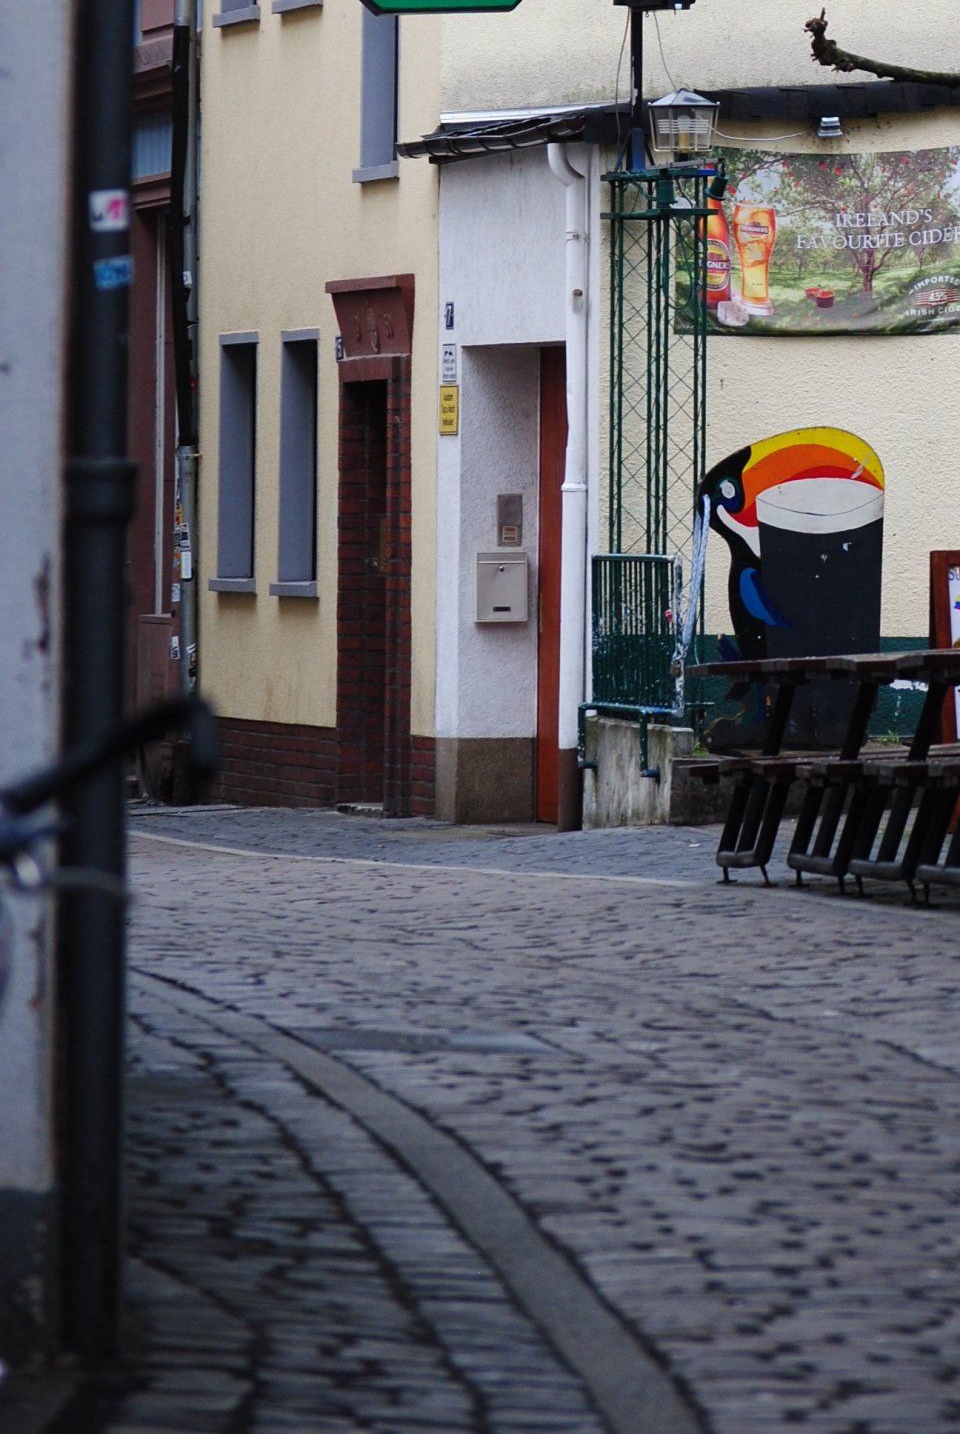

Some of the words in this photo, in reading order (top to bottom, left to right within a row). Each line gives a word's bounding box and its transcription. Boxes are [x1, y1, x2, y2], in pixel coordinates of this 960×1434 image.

[836, 209, 933, 228] IRELAND'S
[796, 233, 904, 250] FAVOURITE
[914, 276, 960, 291] IMPORTED
[905, 307, 935, 316] IRISH
